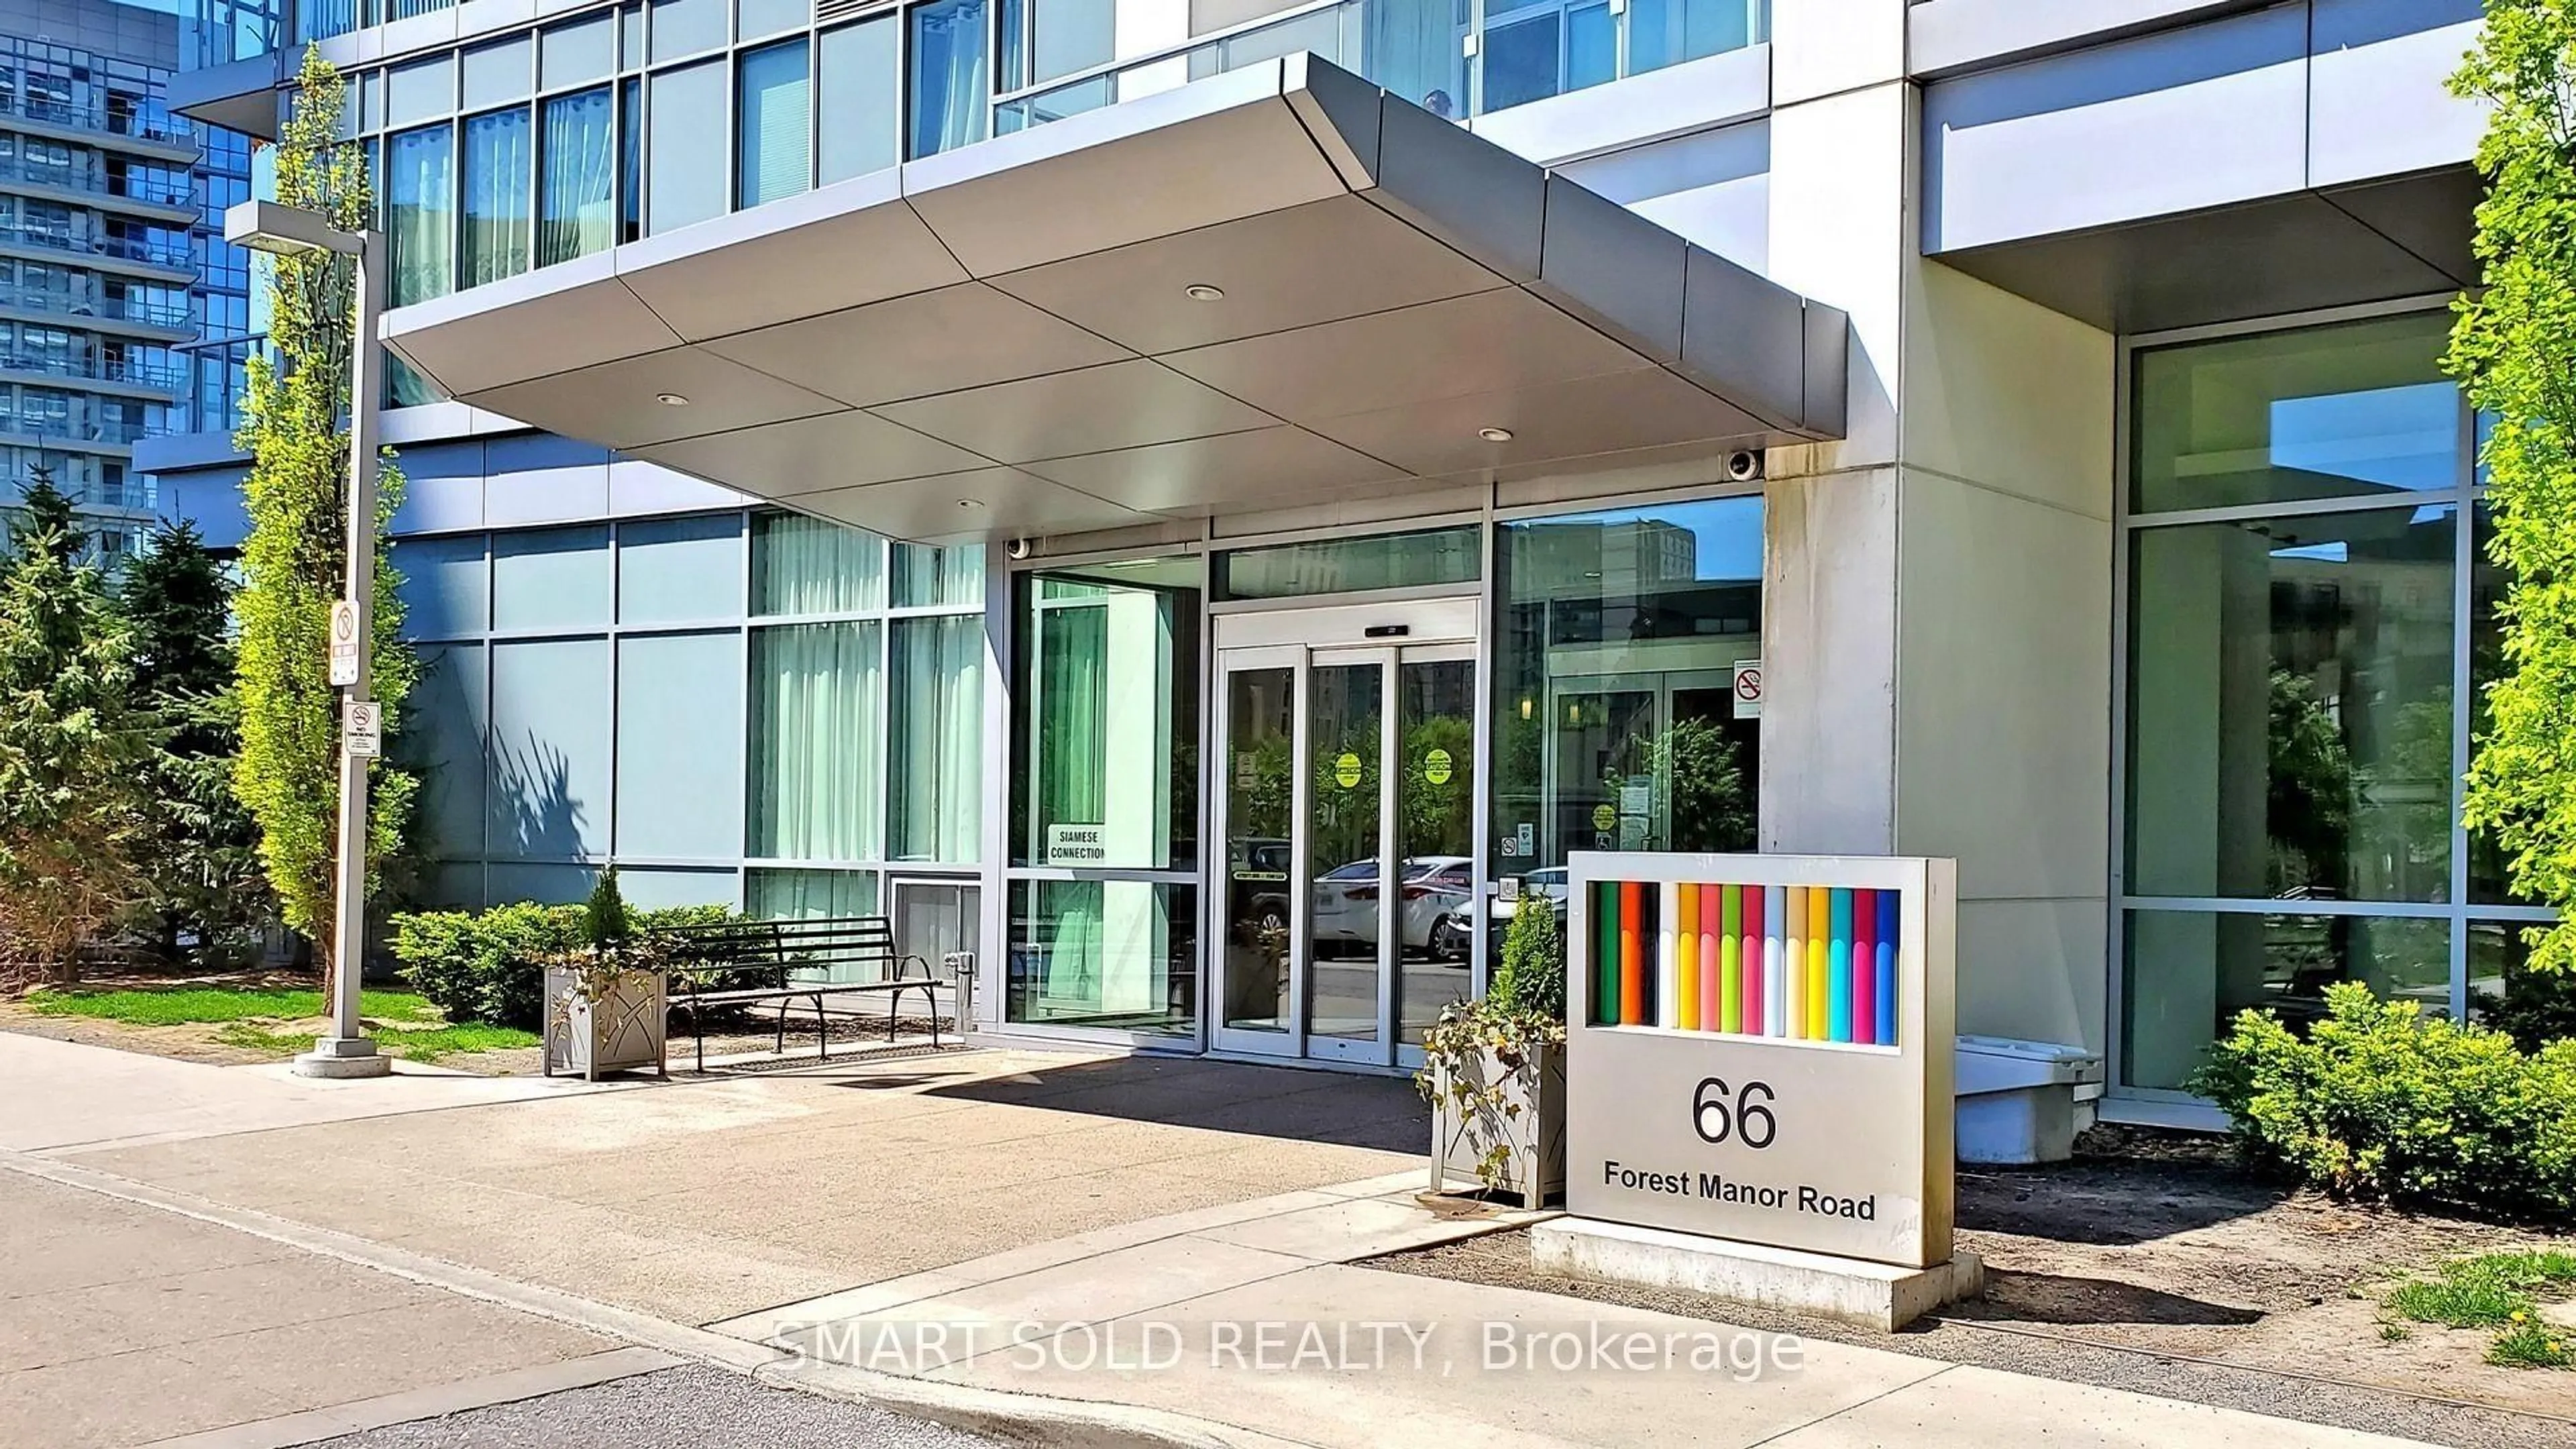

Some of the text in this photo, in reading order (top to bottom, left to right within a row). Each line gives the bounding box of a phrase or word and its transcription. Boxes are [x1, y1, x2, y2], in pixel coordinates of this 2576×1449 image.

[1059, 831, 1098, 843] SIAMESE
[1693, 1077, 1776, 1148] 66
[1605, 1161, 1876, 1220] Forest Manor Road
